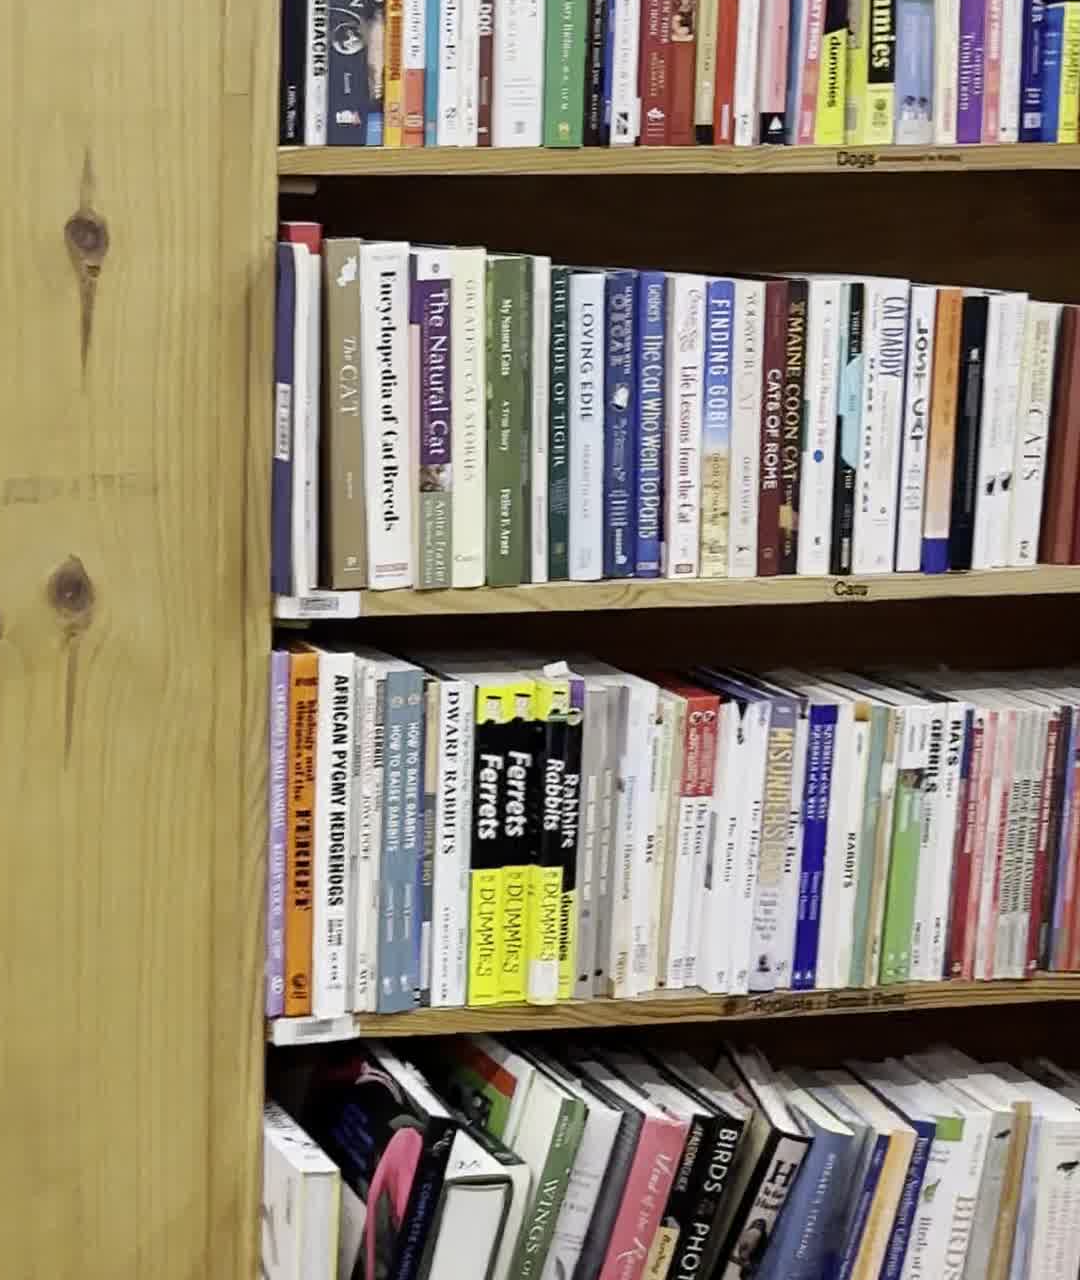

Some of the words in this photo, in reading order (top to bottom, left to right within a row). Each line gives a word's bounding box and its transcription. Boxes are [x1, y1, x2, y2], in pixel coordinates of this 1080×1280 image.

[827, 36, 840, 108] dummies
[836, 151, 876, 168] Dogs
[428, 288, 449, 326] The
[554, 278, 567, 312] THE
[882, 296, 904, 321] CAT
[343, 336, 357, 361] The
[376, 270, 397, 400] Encyclopedia
[500, 317, 512, 352] Natural
[553, 320, 567, 374] TRIBE
[580, 302, 595, 374] LOVING
[644, 334, 664, 361] The
[709, 299, 730, 375] FINDING
[786, 317, 806, 376] MAINE
[879, 327, 903, 378] DADDY
[338, 364, 358, 417] CAT
[428, 335, 448, 413] Natural
[553, 383, 566, 405] OF
[642, 365, 662, 395] Cat
[679, 366, 697, 390] Life
[381, 404, 398, 424] of
[642, 397, 661, 431] Who
[679, 393, 695, 444] Lessons
[766, 415, 779, 438] OF
[785, 385, 803, 440] COON
[382, 431, 398, 461] Cat
[428, 420, 448, 455] Cat
[552, 412, 565, 468] TIGER
[641, 434, 660, 471] Went
[641, 476, 659, 493] To
[678, 448, 694, 476] from
[763, 443, 779, 490] ROME
[782, 446, 802, 482] CAT
[381, 465, 398, 532] Breeds
[678, 476, 692, 498] the
[638, 496, 659, 538] Paris
[677, 501, 692, 525] Cat
[332, 675, 350, 744] AFRICAN
[443, 690, 459, 762] DWARF
[389, 724, 401, 750] HOW
[406, 721, 418, 749] HOW
[946, 720, 962, 767] RATS
[331, 750, 347, 806] PYGMY
[389, 753, 400, 767] TO
[405, 752, 417, 768] TO
[388, 771, 400, 799] RAISE
[405, 771, 417, 797] RAISE
[479, 754, 503, 840] Ferrets
[506, 750, 532, 837] Ferrets
[543, 758, 566, 831] Rabbits
[386, 802, 399, 851] RABBITS
[404, 800, 416, 849] RABBITS
[442, 770, 457, 855] RABBITS
[328, 811, 345, 907] HEDGEHOGS
[843, 832, 857, 889] RABBITS
[477, 888, 499, 977] DUMMIES
[502, 884, 522, 974] DUMMIES
[541, 883, 558, 962] DUMMIES
[702, 1127, 738, 1194] BIRDS
[525, 1177, 560, 1254] WINGS
